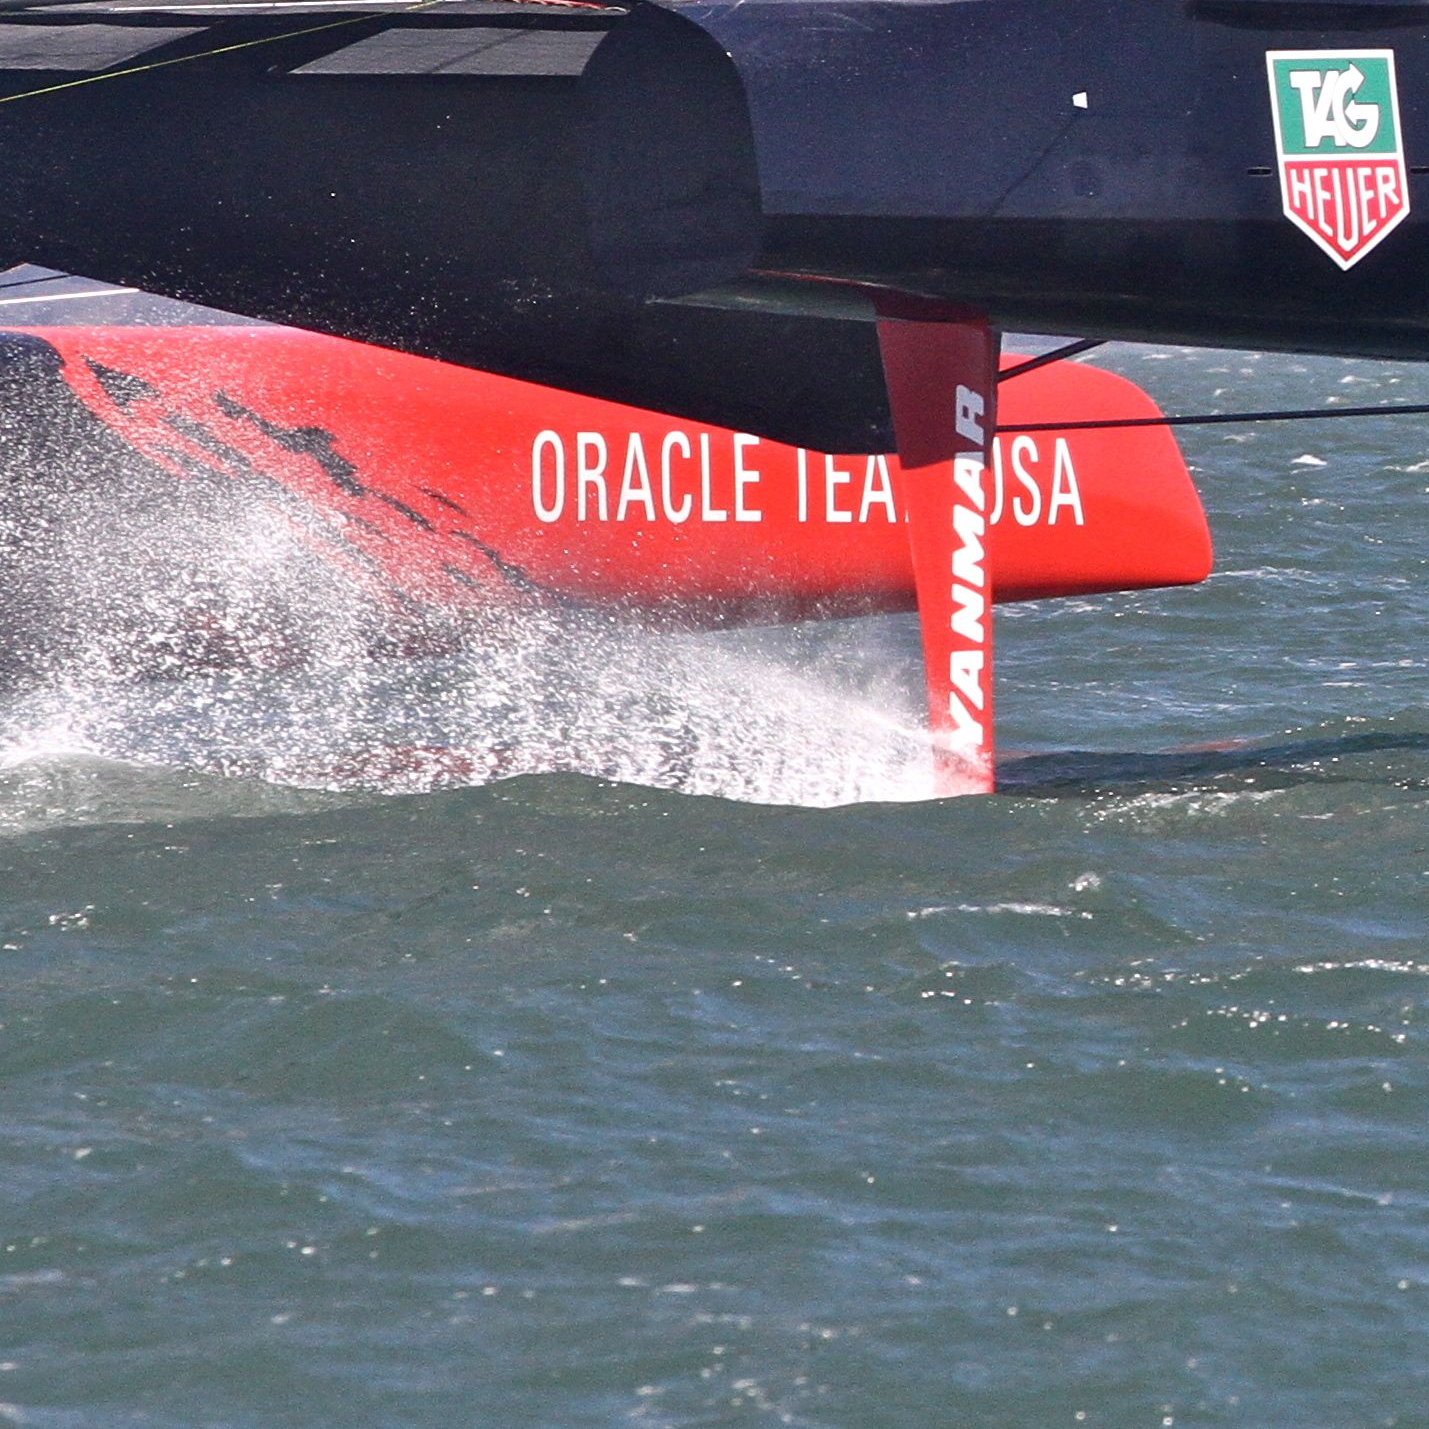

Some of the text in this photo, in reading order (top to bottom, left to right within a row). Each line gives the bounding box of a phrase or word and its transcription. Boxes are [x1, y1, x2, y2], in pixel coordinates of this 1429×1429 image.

[1289, 60, 1380, 149] TAG
[1287, 166, 1401, 253] HEUER
[530, 428, 763, 524] ORACLE
[796, 452, 909, 523] TEA
[950, 383, 986, 754] YANMAR
